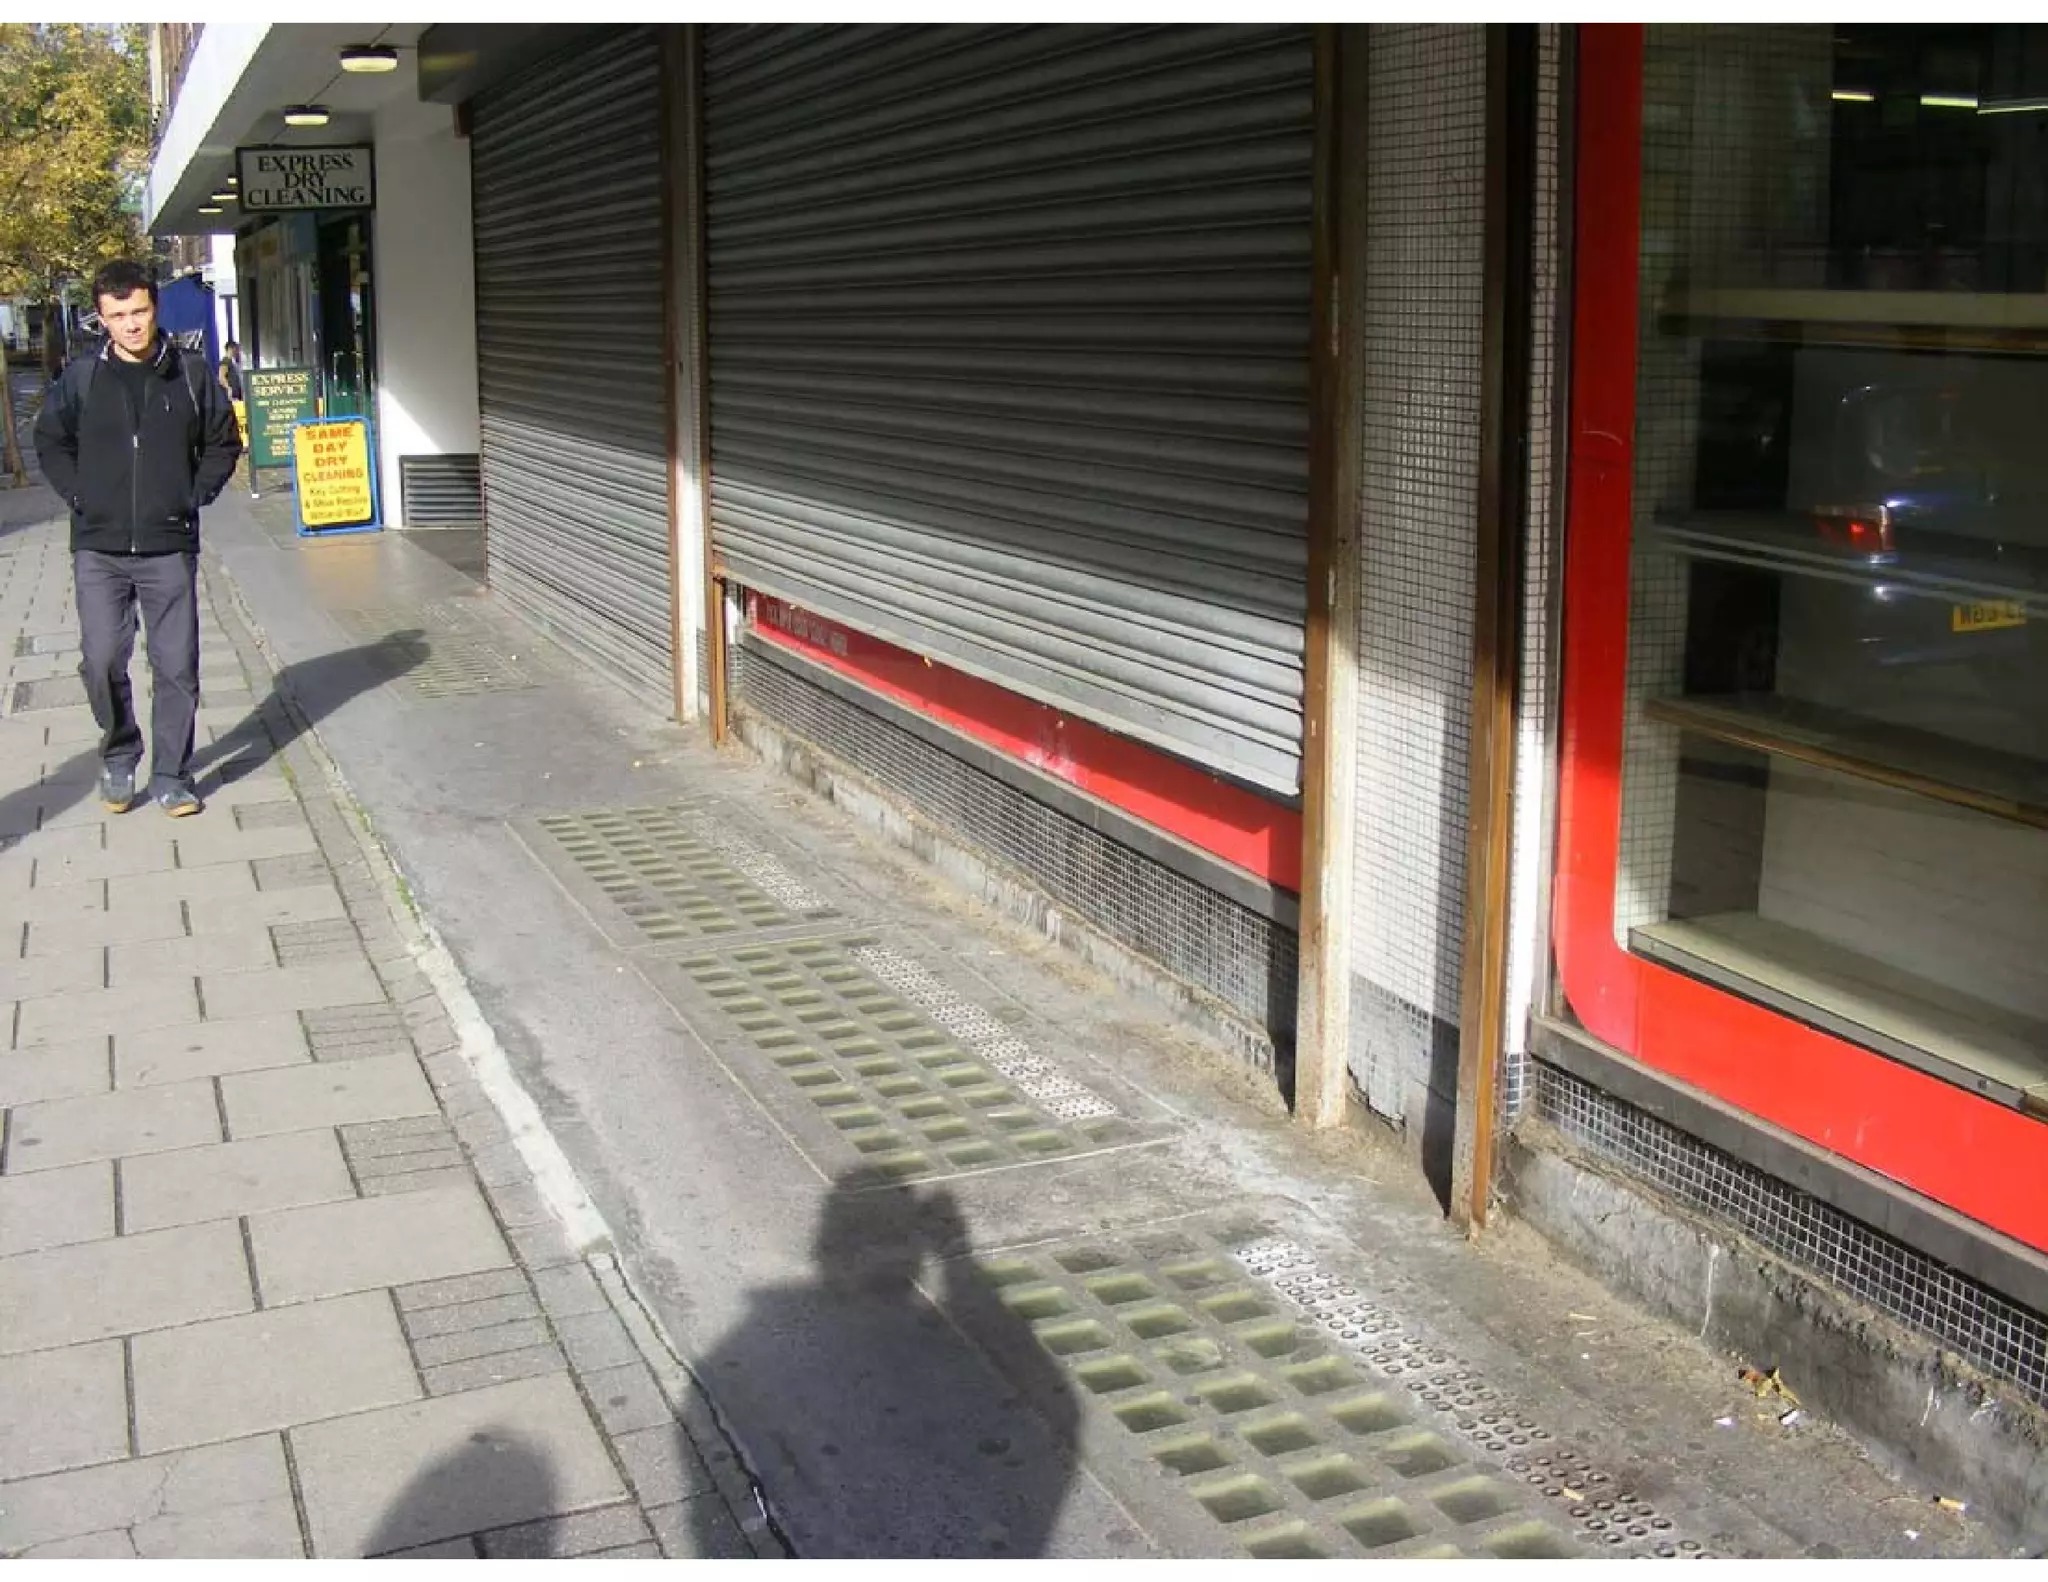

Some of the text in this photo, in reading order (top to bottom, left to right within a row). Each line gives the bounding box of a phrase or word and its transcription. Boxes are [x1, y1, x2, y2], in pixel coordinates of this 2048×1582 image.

[257, 153, 354, 172] EXPRESS
[284, 172, 326, 188] DRY
[248, 186, 365, 205] CLEANING
[251, 373, 308, 386] EXPRESS
[254, 384, 307, 397] SERVICE
[306, 427, 353, 440] SAME
[313, 442, 347, 454] DAY
[315, 456, 347, 467] DRY
[303, 468, 364, 483] CLEANING
